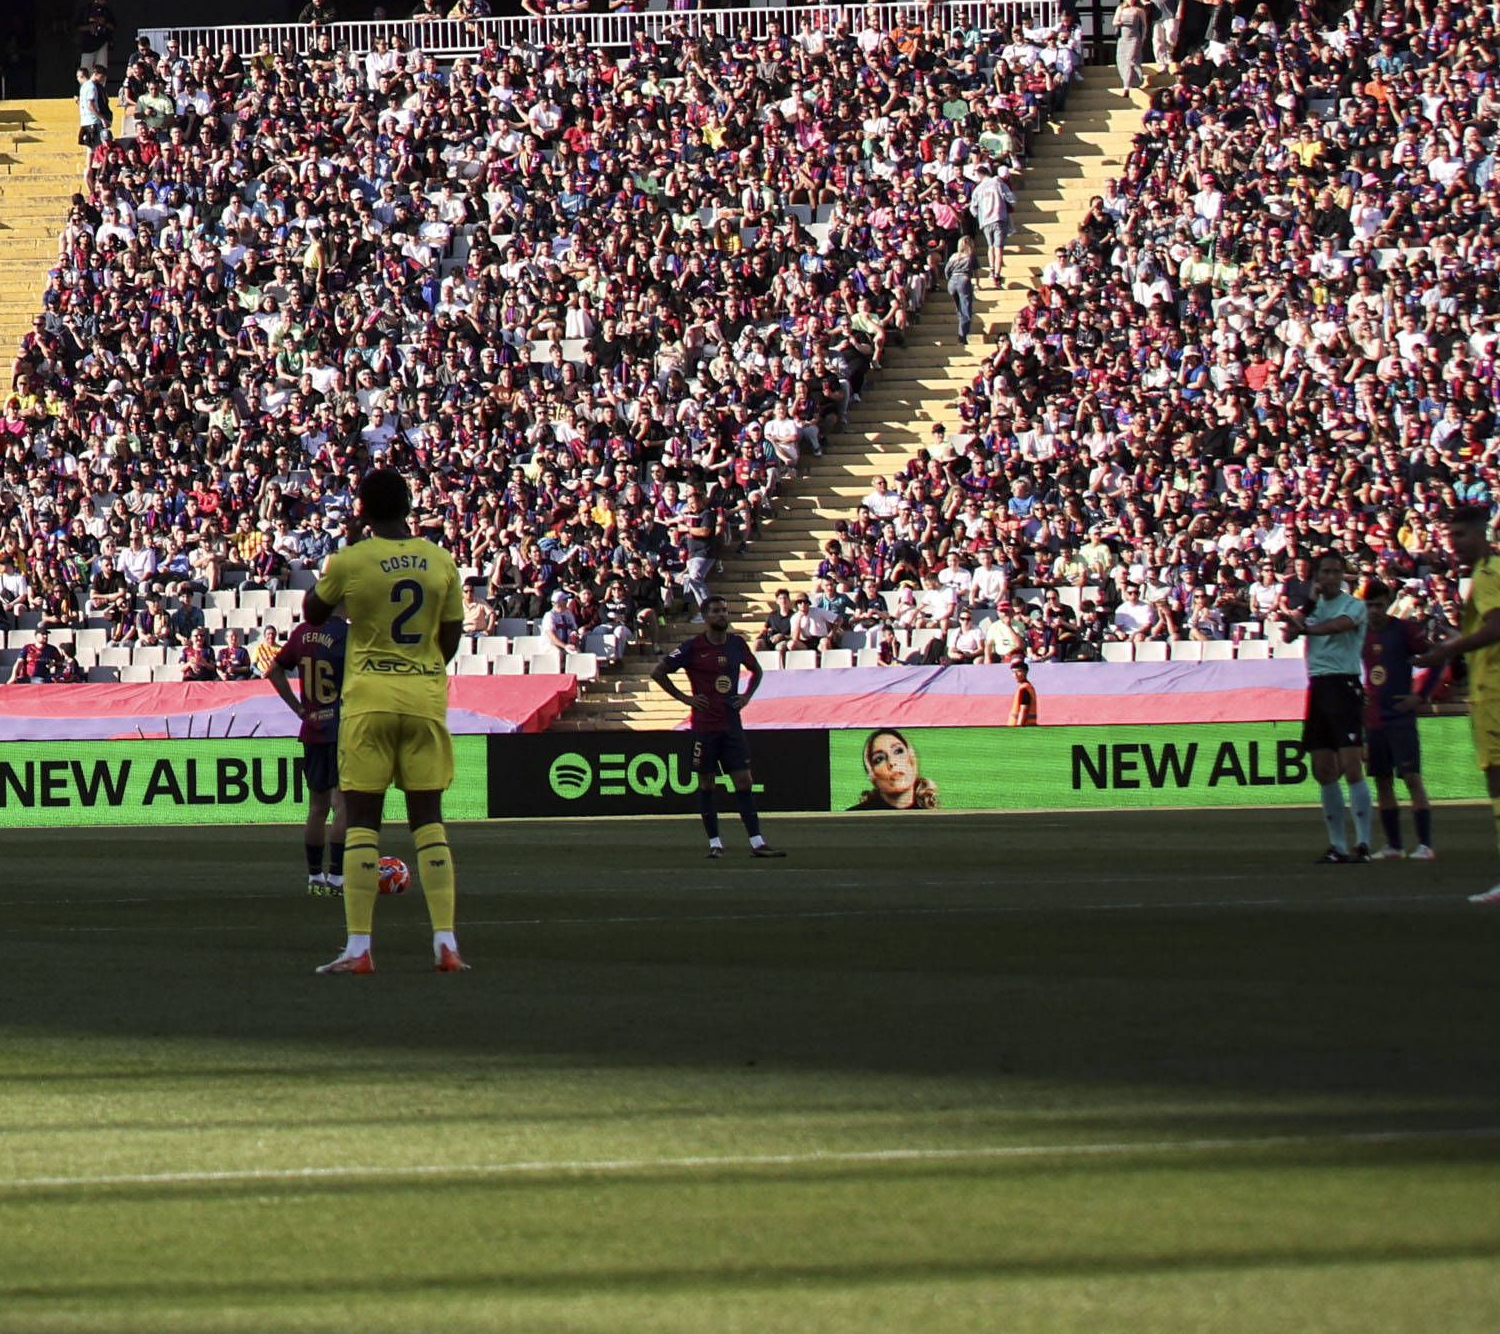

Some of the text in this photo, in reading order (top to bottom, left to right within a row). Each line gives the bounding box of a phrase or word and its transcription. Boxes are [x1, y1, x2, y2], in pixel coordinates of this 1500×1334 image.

[379, 555, 428, 573] COSTA
[390, 579, 424, 644] 2
[300, 656, 338, 704] 16
[360, 659, 442, 676] ASCALE
[1071, 742, 1198, 790] NEW
